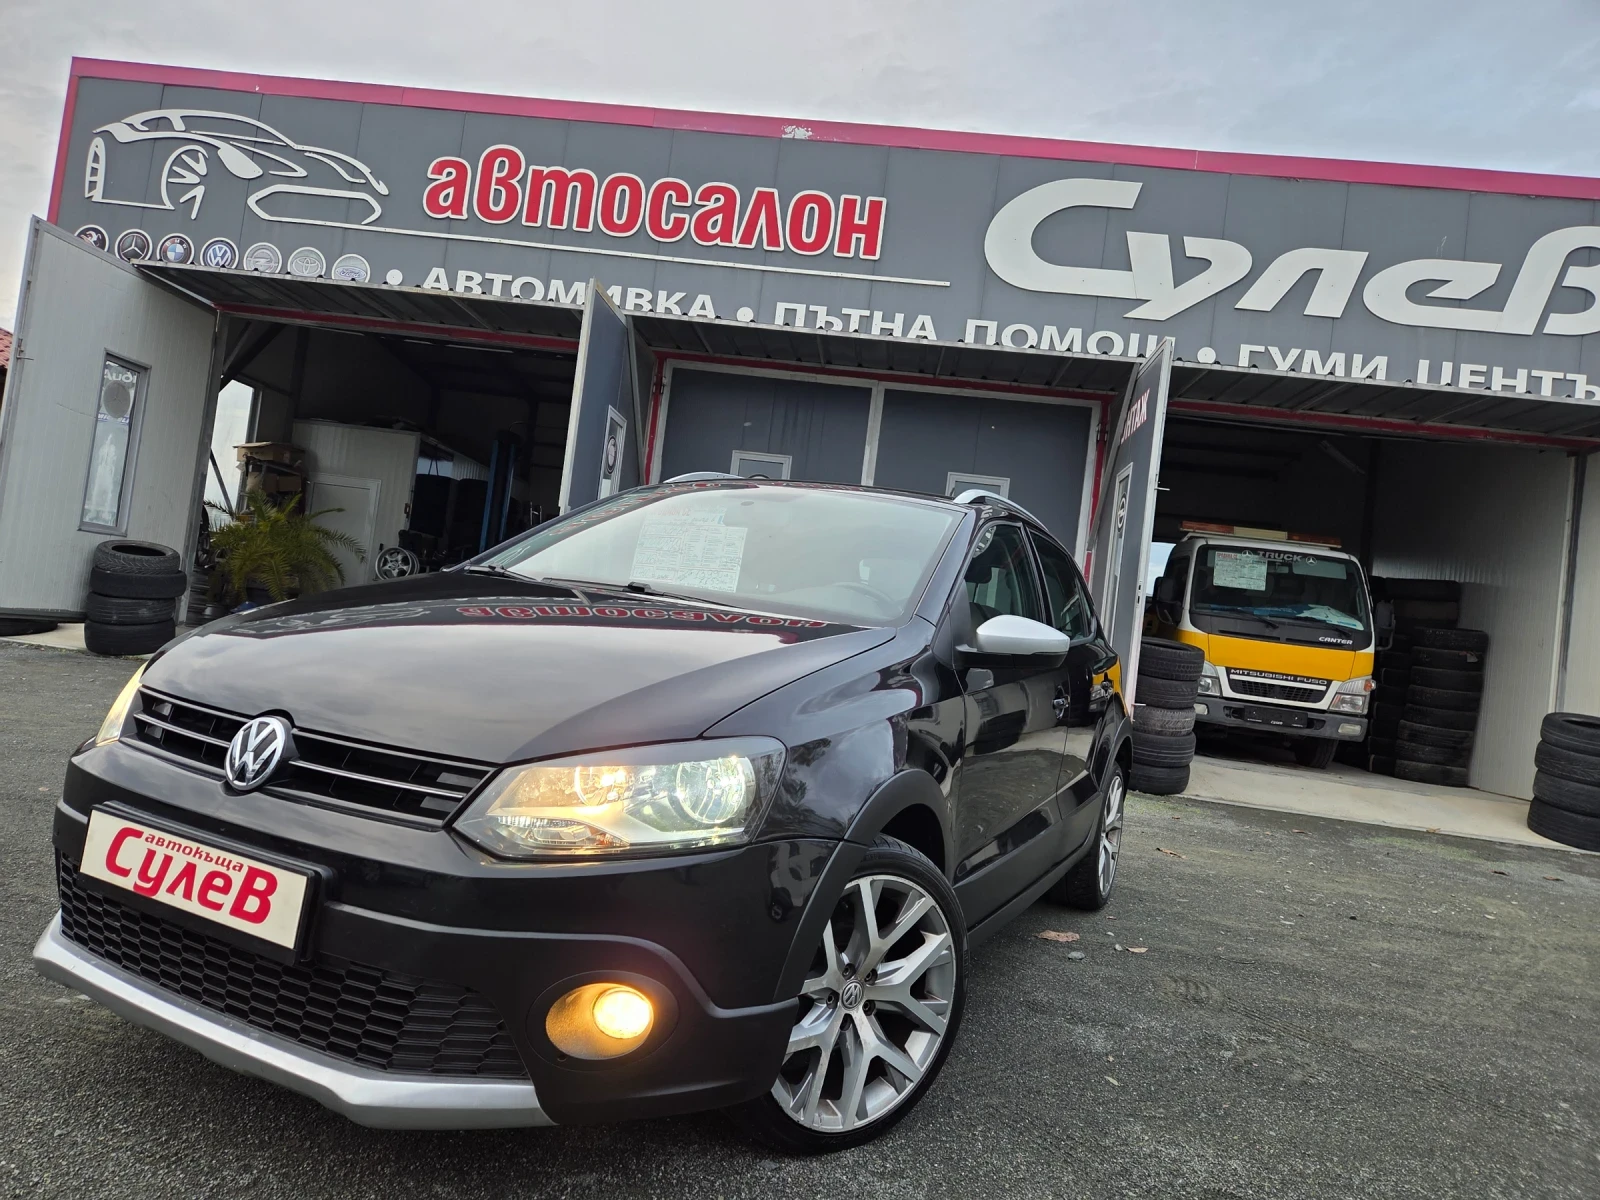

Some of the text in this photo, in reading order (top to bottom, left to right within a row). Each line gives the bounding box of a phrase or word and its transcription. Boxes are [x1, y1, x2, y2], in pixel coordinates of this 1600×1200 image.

[423, 144, 887, 261] автосалон
[774, 302, 937, 341] ПЪТНА
[1238, 344, 1388, 380] ГУМИ
[1258, 551, 1303, 562] TRUCK
[1318, 636, 1353, 645] CANTER
[1230, 669, 1328, 685] MITSUBISHI FUSO
[144, 833, 244, 873] автокъща
